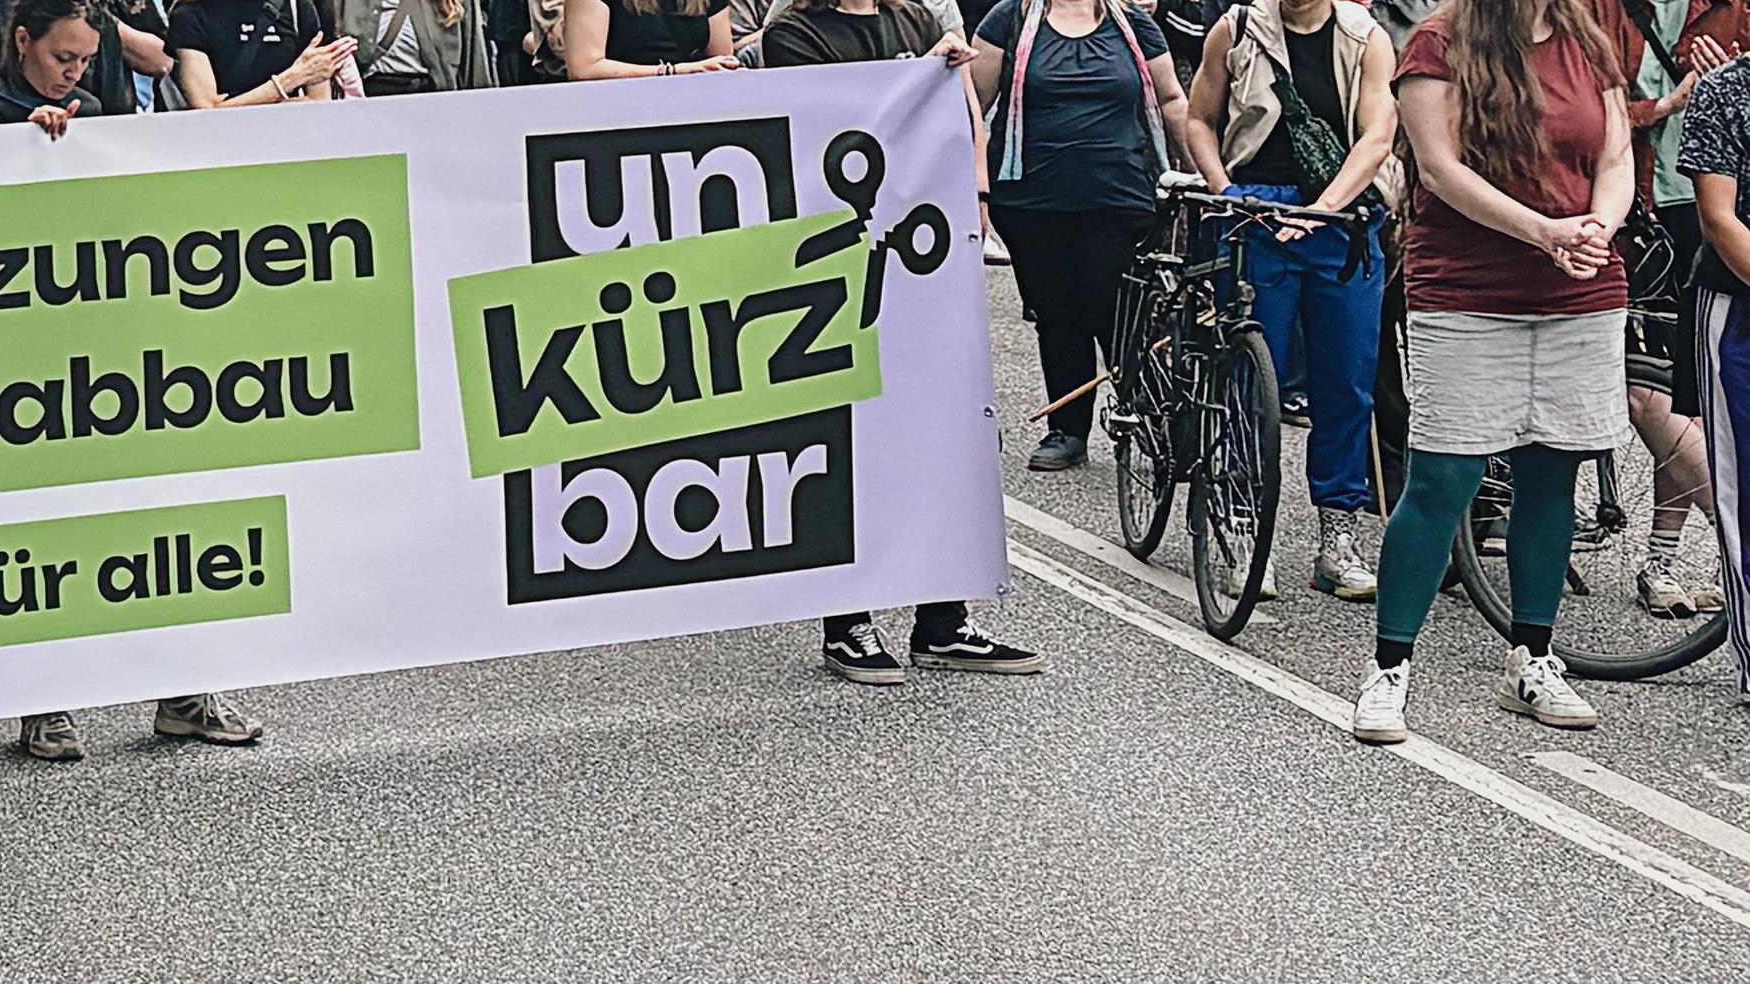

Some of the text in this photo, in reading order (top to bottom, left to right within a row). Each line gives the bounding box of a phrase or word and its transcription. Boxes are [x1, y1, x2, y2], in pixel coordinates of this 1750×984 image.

[554, 145, 770, 255] un
[483, 271, 854, 437] kürz
[97, 527, 266, 604] alle!
[531, 443, 828, 574] bar
